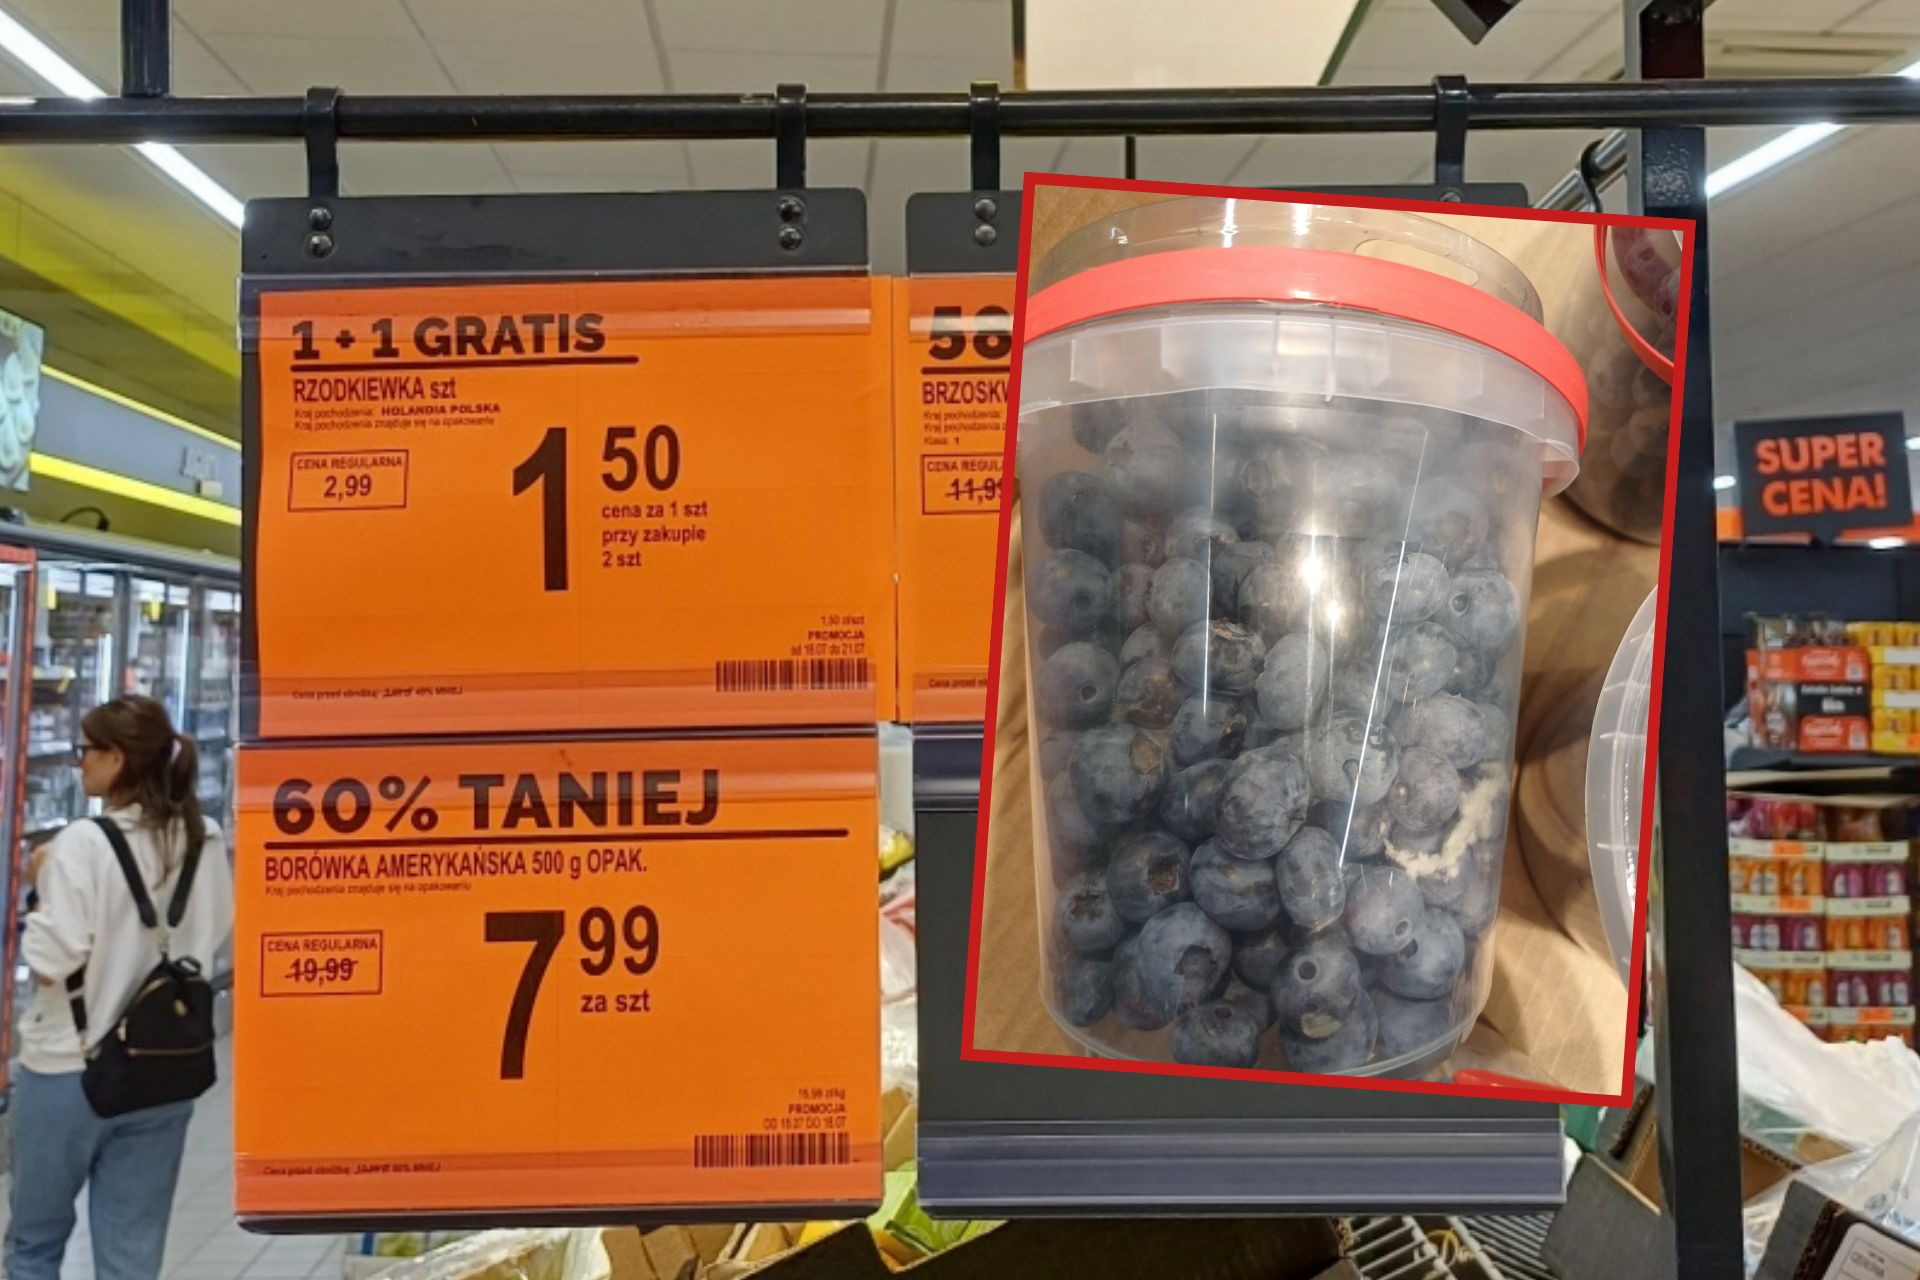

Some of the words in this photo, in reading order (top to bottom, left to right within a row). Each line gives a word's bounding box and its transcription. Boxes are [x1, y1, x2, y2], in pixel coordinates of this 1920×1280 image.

[292, 321, 320, 360] 1
[336, 330, 355, 348] +
[372, 318, 400, 358] 1
[414, 314, 606, 357] GRATIS
[294, 376, 425, 402] RZODKIEWKA
[430, 378, 456, 399] szt
[294, 409, 312, 420] Kraj
[382, 406, 446, 416] HOLANDIA
[450, 404, 500, 414] POLSKA
[294, 421, 312, 432] Kraj
[314, 420, 372, 431] pochodzenia
[375, 419, 412, 430] znajduje
[414, 418, 426, 429] się
[428, 418, 440, 426] na
[442, 416, 494, 427] opakowaniu
[296, 458, 328, 470] CENA
[331, 456, 402, 470] REGULARNA
[1756, 432, 1886, 474] SUPER
[927, 462, 958, 472] CENA
[961, 460, 1002, 472] REGUL
[324, 474, 372, 501] 2,99
[1762, 473, 1887, 517] CENA!
[513, 427, 568, 591] 1
[602, 424, 680, 491] 50
[602, 505, 642, 518] cena
[646, 504, 664, 518] za
[669, 502, 678, 516] 1
[684, 502, 708, 516] szt
[602, 529, 638, 546] przy
[644, 525, 706, 544] zakupie
[602, 552, 612, 566] 2
[617, 551, 642, 566] szt
[808, 630, 864, 640] PROMOCJA
[272, 775, 439, 835] 60%
[458, 768, 720, 830] TANIEJ
[266, 849, 370, 881] BORÓWKA
[375, 846, 526, 878] AMERYKAŃSKA
[532, 850, 565, 876] 500
[569, 855, 581, 880] g
[586, 848, 648, 874] OPAK.
[266, 886, 283, 897] Kraj
[287, 885, 344, 896] pochodzenia
[348, 884, 385, 896] znajduje
[388, 884, 400, 894] się
[418, 882, 472, 894] opakowaniu
[268, 940, 299, 952] CENA
[303, 938, 378, 951] REGULARNA
[288, 957, 355, 986] 19,99
[484, 910, 564, 1080] 7
[580, 904, 659, 976] 99
[580, 994, 608, 1012] za
[616, 989, 650, 1012] szt
[789, 1104, 845, 1114] PROMOCJA
